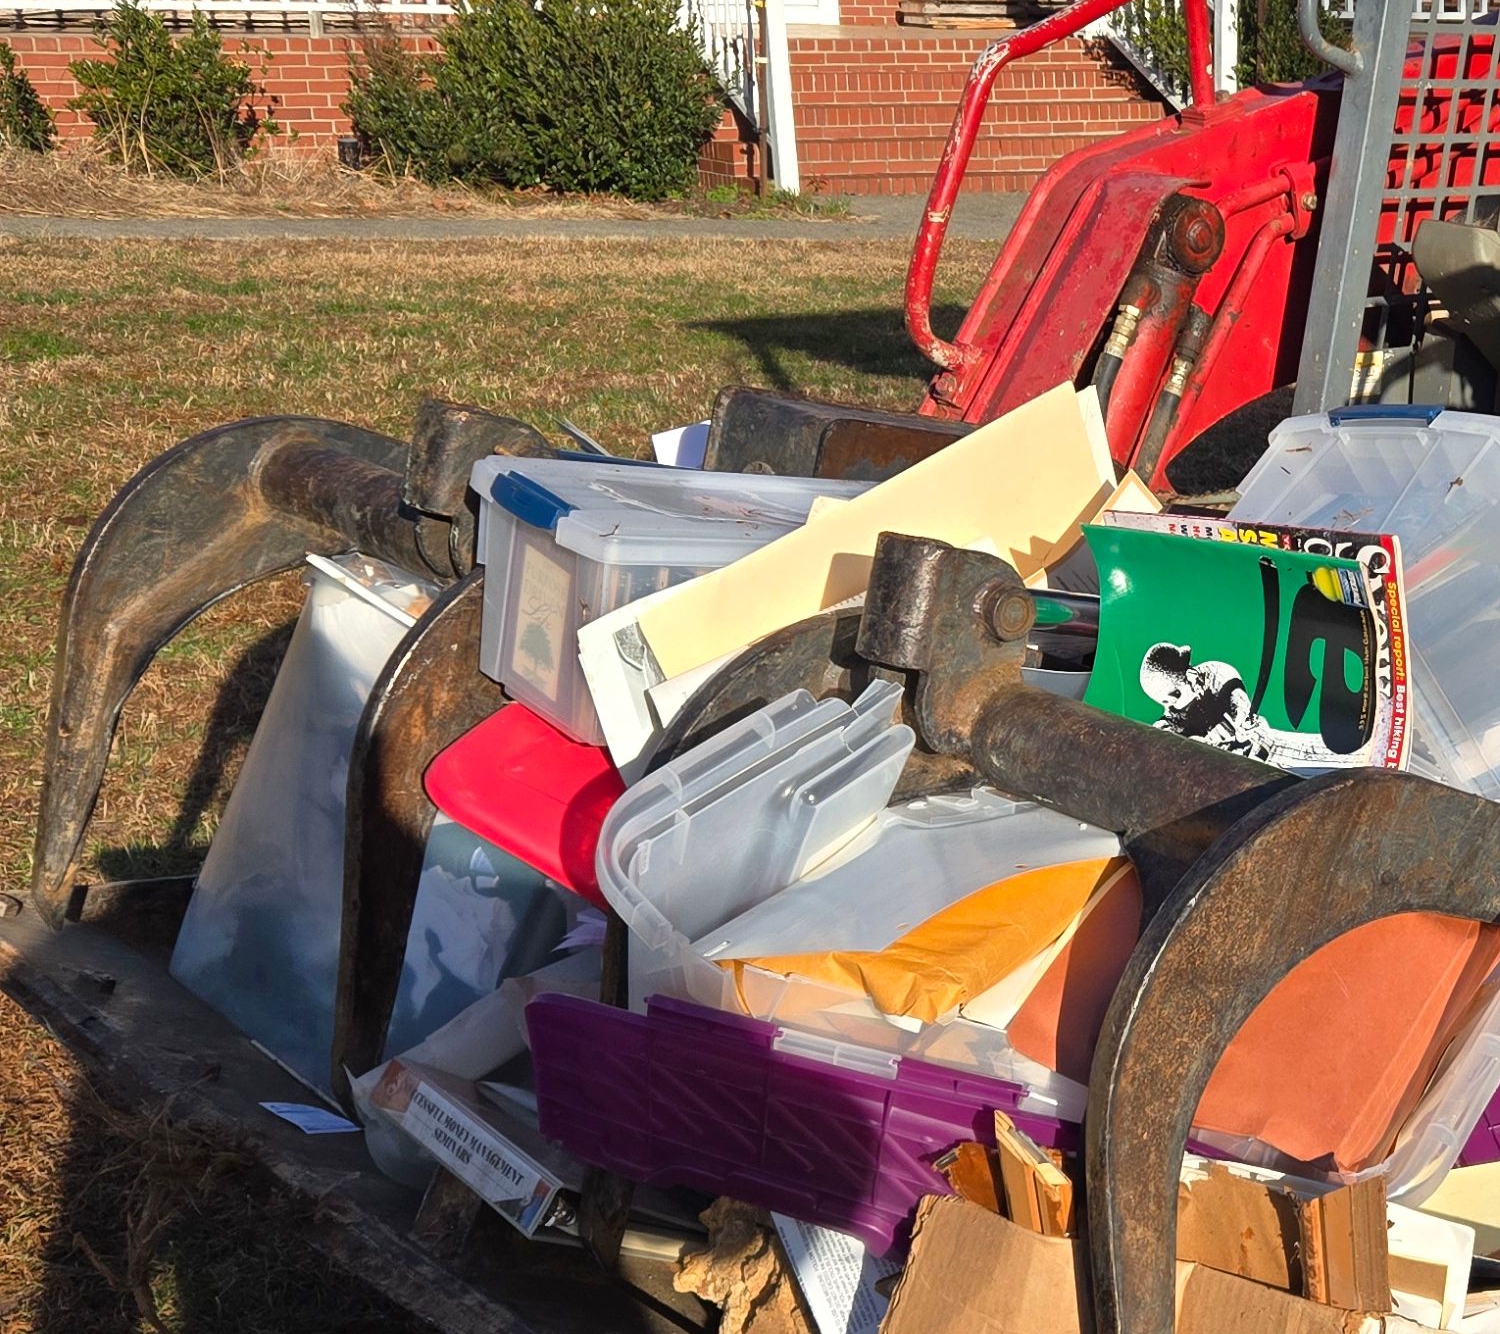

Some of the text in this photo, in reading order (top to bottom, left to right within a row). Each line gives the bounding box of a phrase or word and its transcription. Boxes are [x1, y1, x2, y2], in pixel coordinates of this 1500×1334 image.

[1386, 582, 1401, 636] Special
[1393, 636, 1405, 680] report:
[1396, 684, 1405, 714] Best
[1387, 717, 1405, 759] hiking
[433, 1128, 473, 1164] SEMINARS
[444, 1115, 472, 1143] MONEY
[469, 1135, 525, 1186] MANAGEMENT
